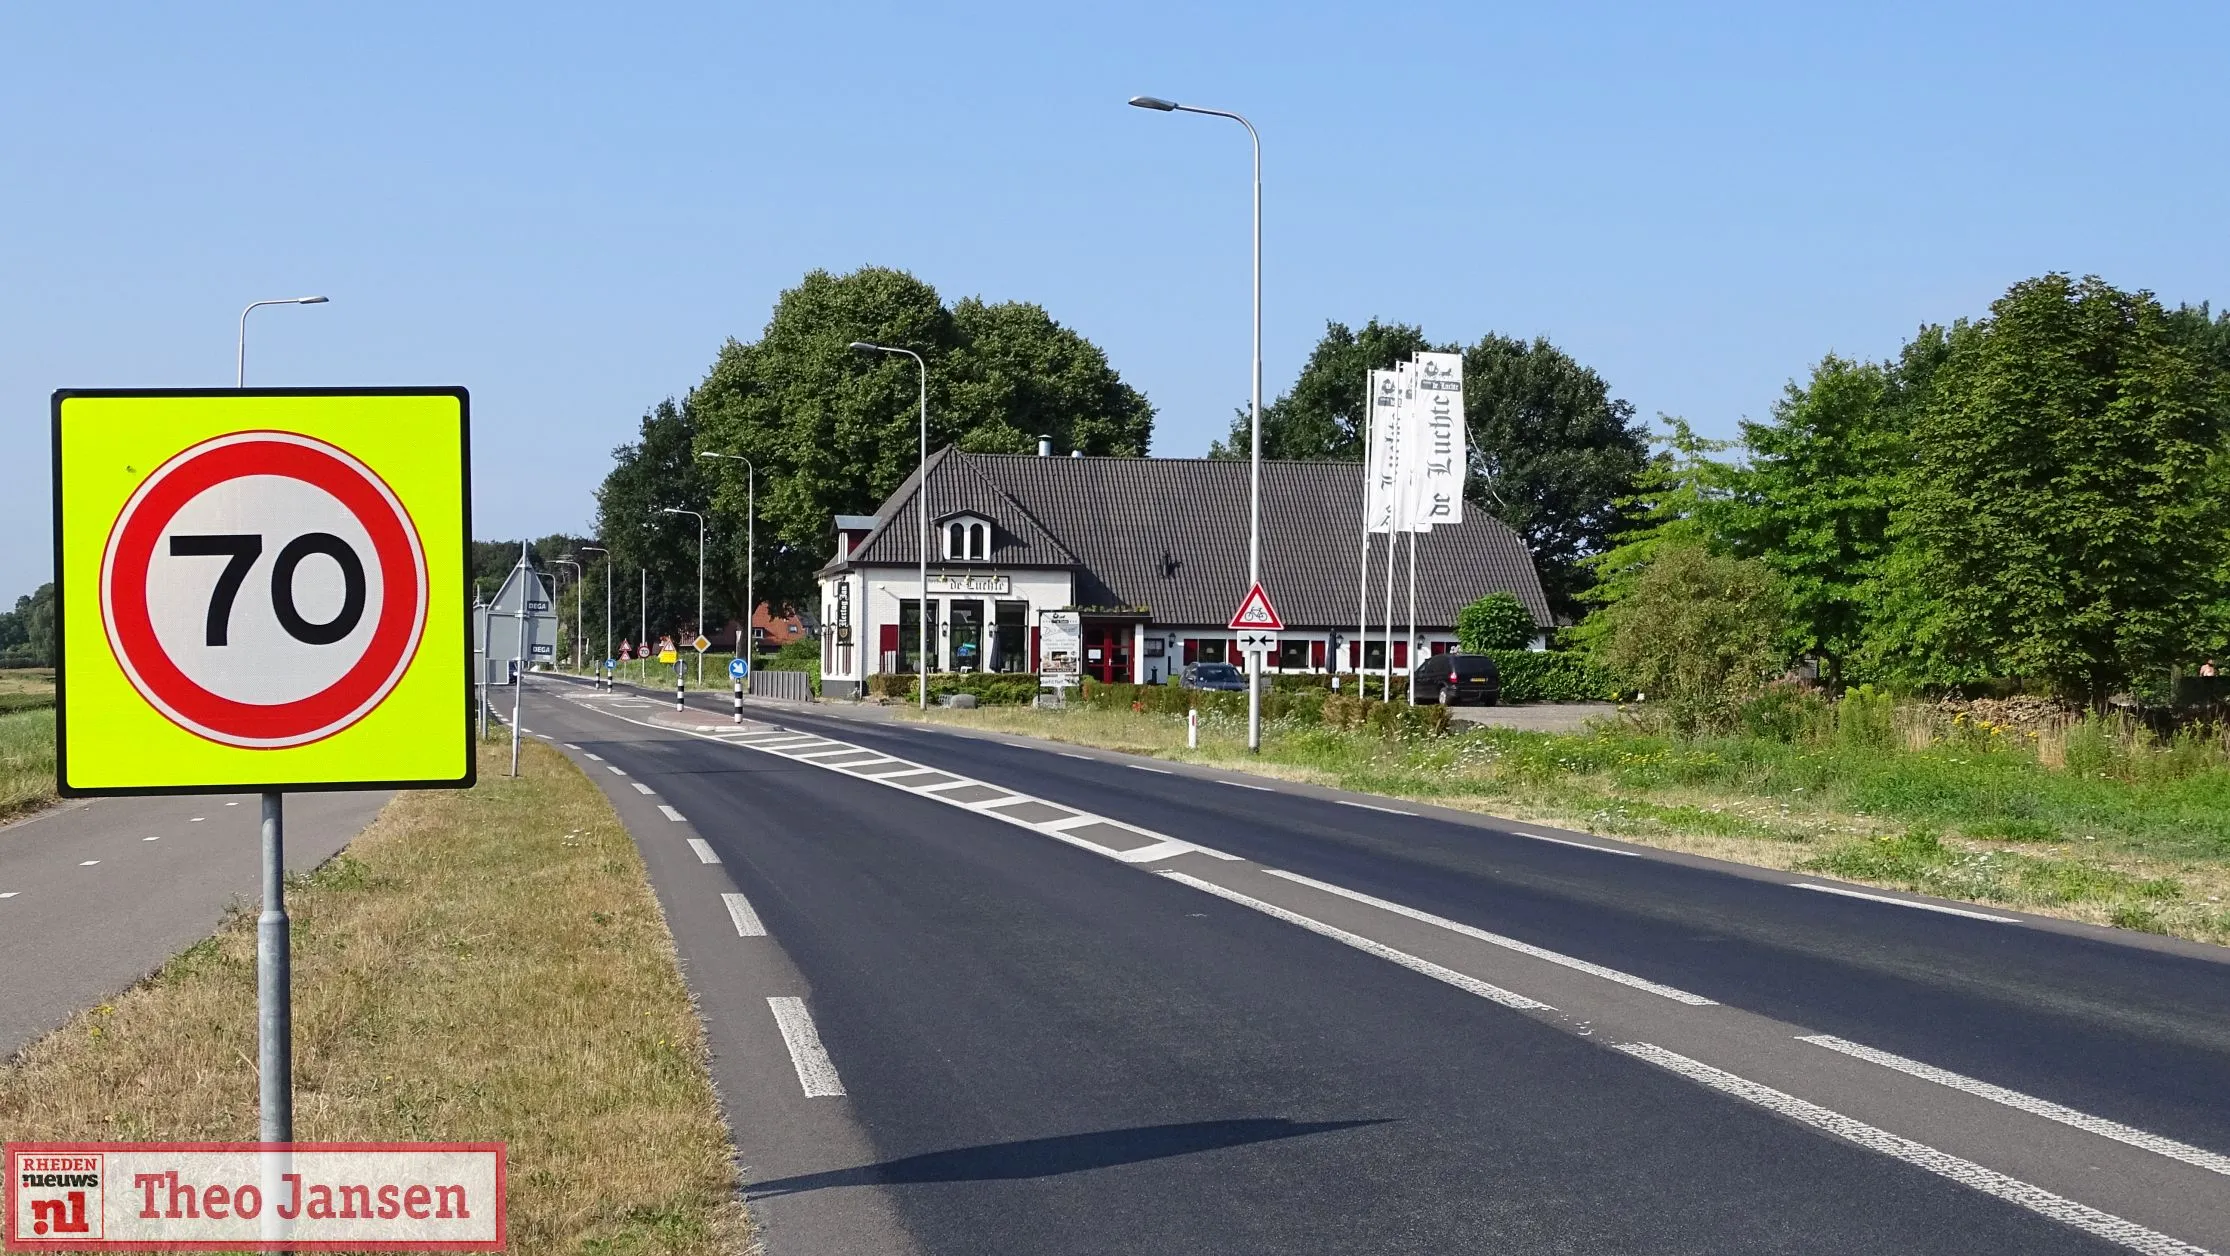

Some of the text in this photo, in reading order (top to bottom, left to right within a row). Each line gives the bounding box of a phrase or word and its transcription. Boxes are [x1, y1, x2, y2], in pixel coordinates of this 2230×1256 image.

[1427, 395, 1454, 479] Luchte
[1429, 493, 1451, 517] de
[169, 532, 367, 647] 70
[528, 602, 546, 610] DEGA
[532, 646, 550, 654] DEGA
